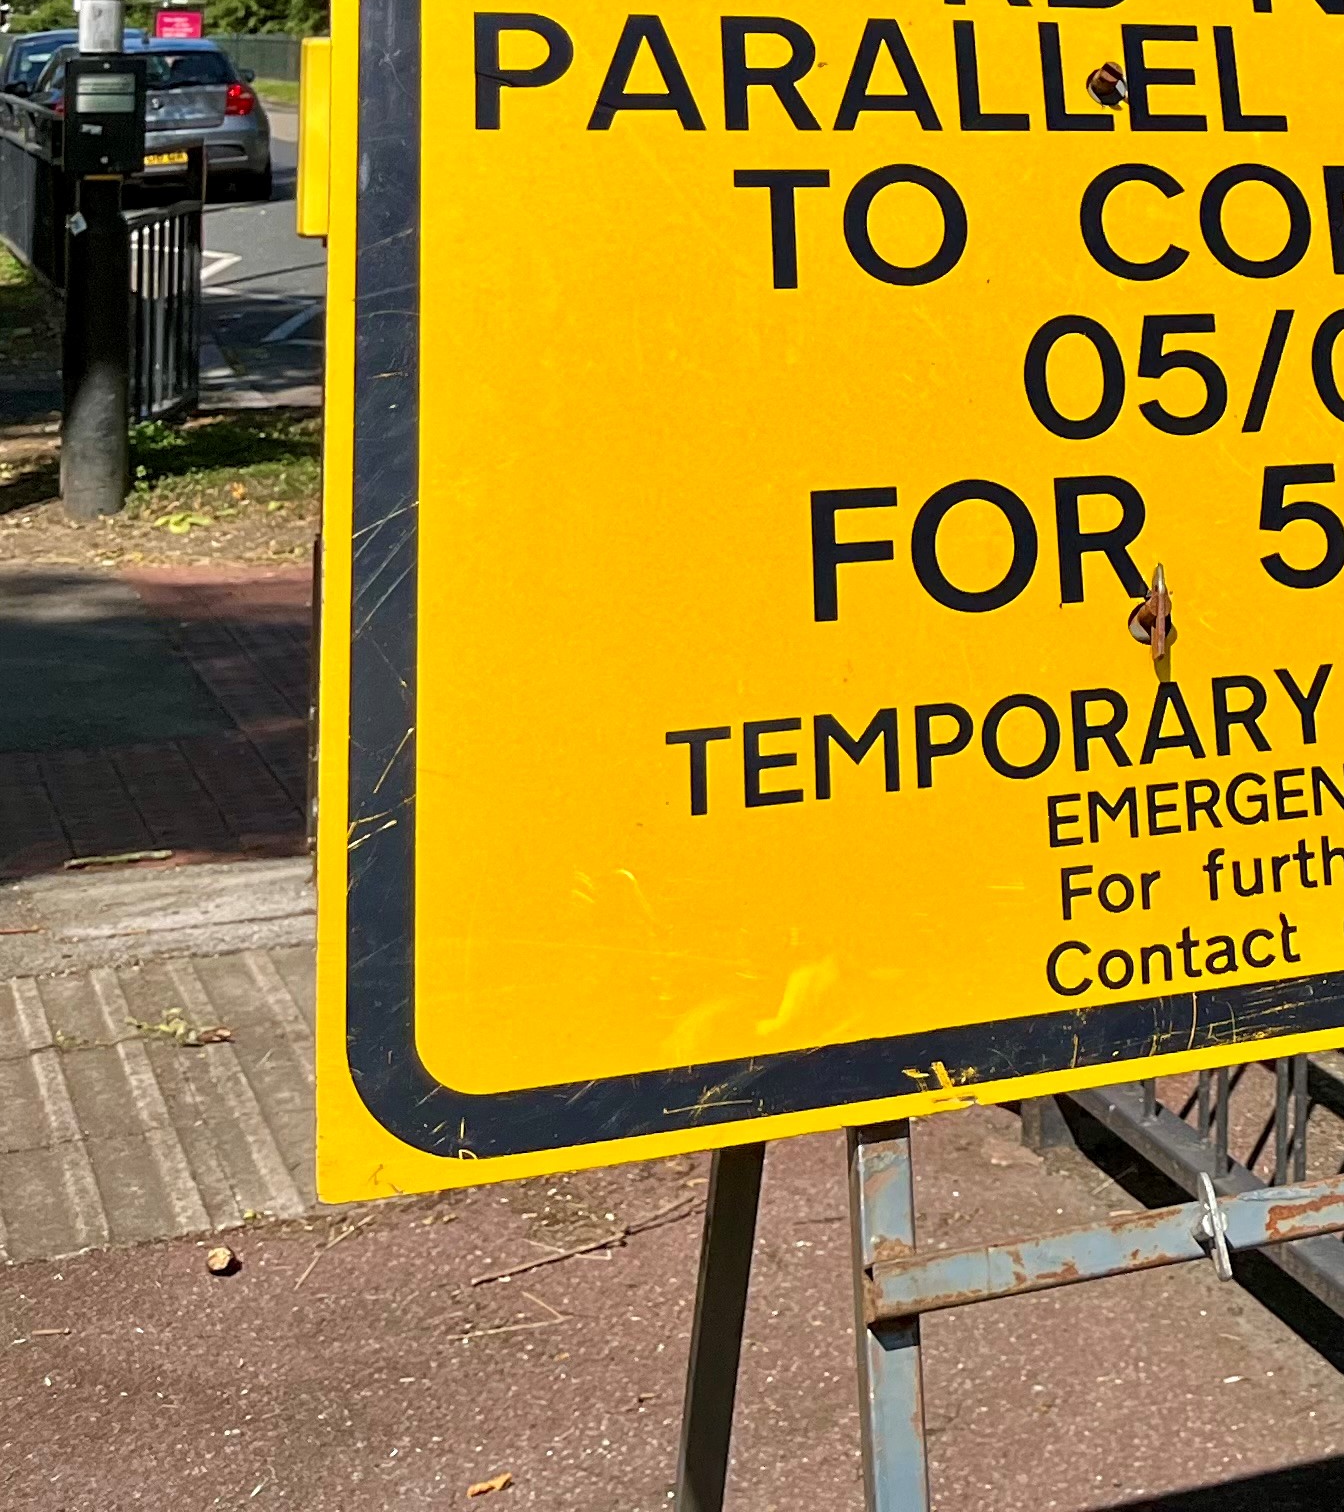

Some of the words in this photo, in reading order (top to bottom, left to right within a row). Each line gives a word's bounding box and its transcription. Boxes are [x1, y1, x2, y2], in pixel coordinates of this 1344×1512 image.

[474, 12, 1288, 132] PARALLEL
[734, 164, 967, 290] TO
[810, 474, 1148, 622] FOR
[666, 664, 1332, 815] TEMPORARY
[1047, 914, 1300, 996] Contact
[1061, 869, 1160, 920] For
